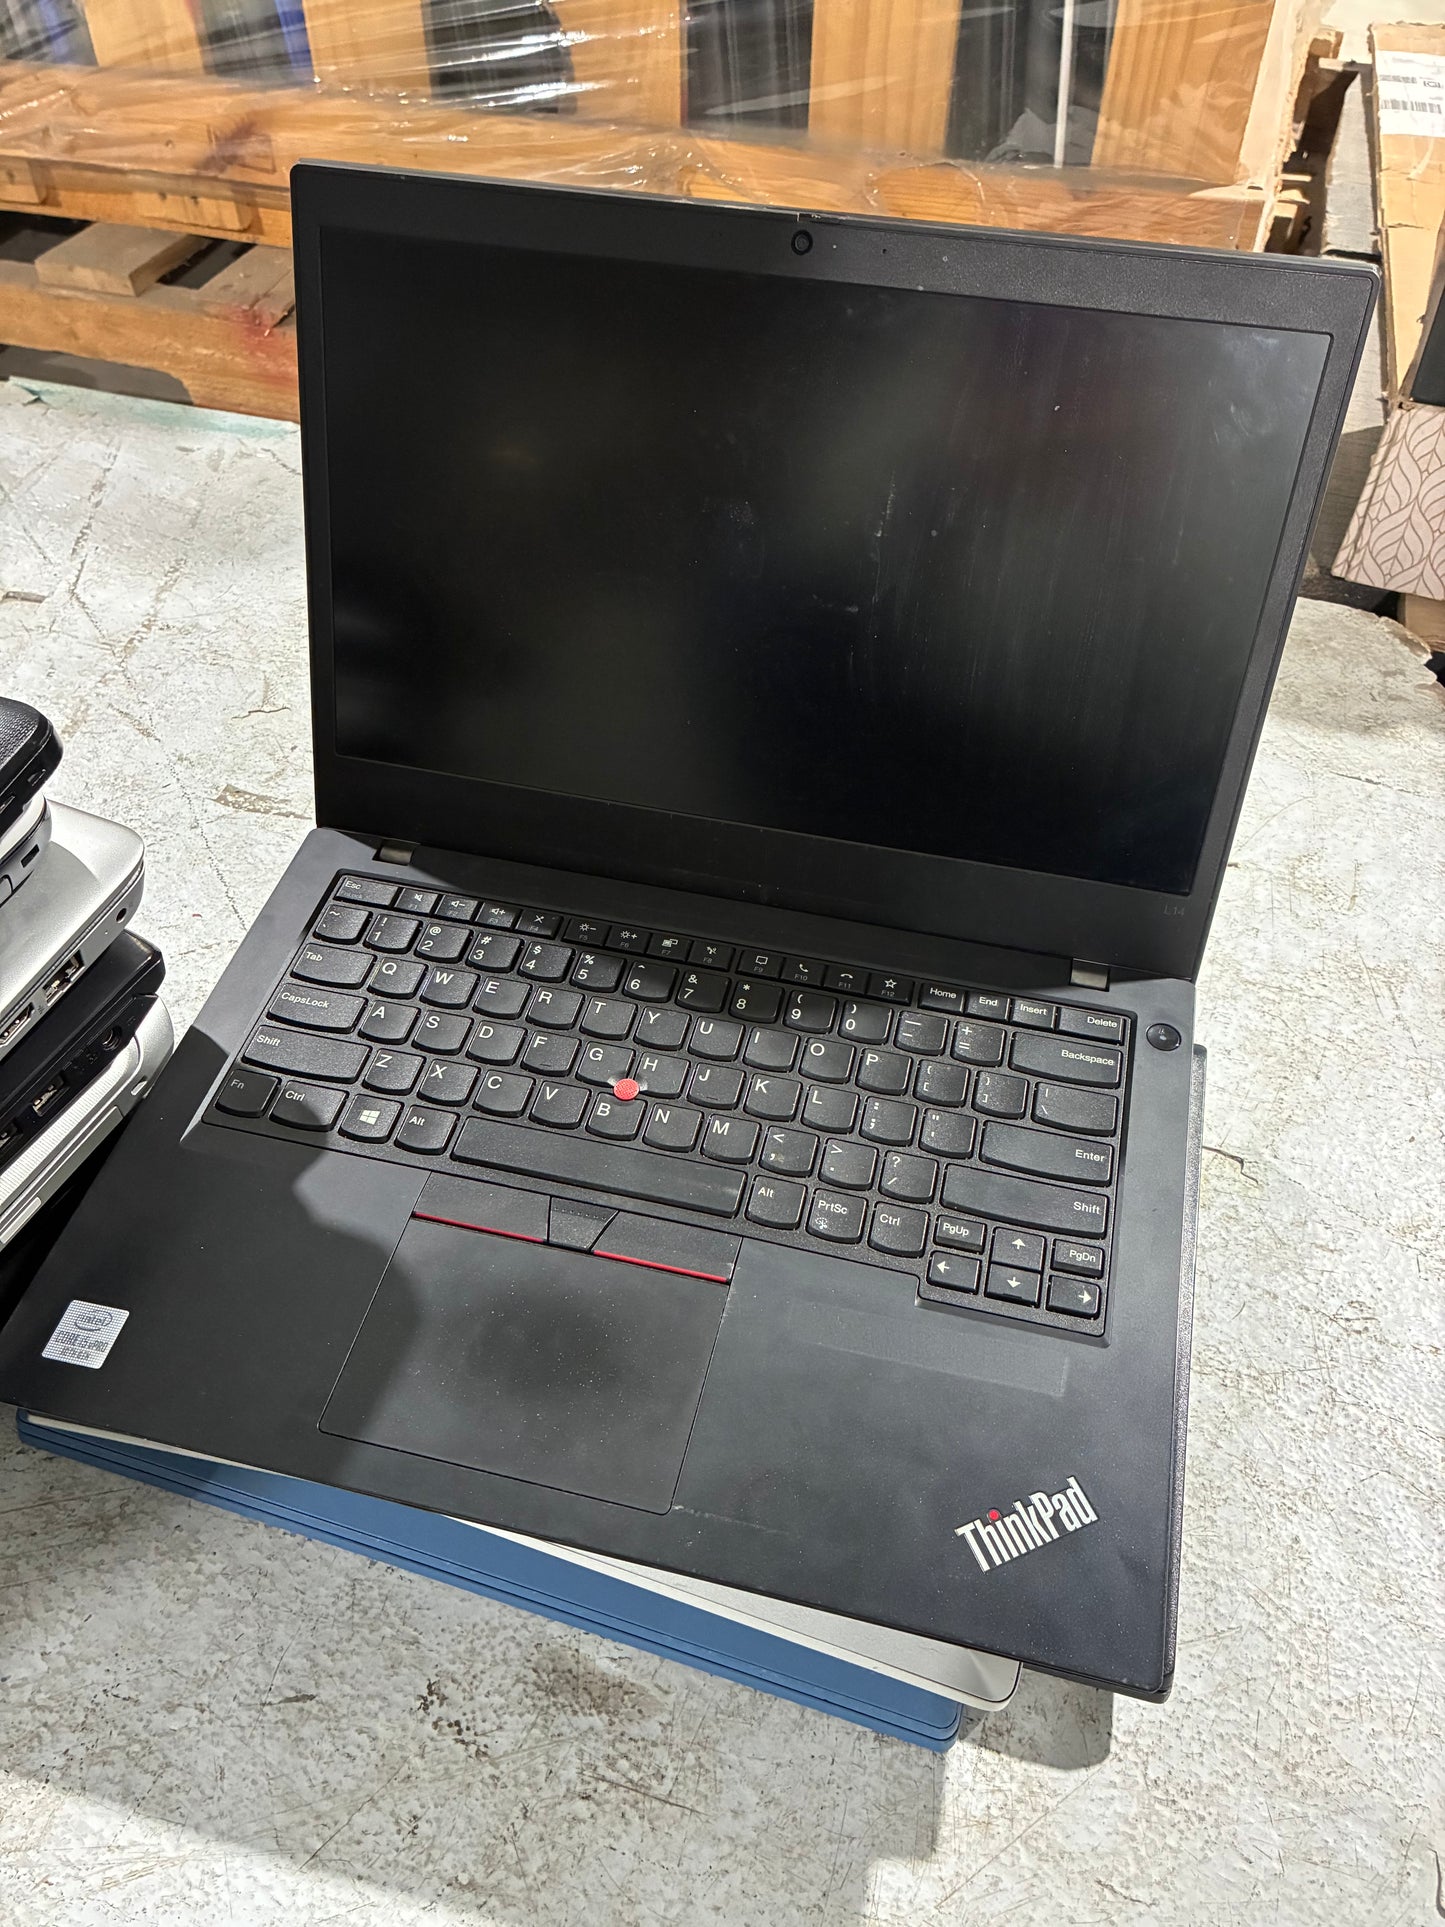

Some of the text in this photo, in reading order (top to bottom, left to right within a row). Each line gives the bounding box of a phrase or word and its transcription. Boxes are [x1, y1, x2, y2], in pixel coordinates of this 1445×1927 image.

[345, 880, 361, 890] Esc
[1164, 905, 1185, 916] L14
[380, 916, 388, 927] !
[374, 931, 380, 941] 1
[429, 925, 442, 937] @
[422, 940, 432, 951] 2
[480, 935, 493, 945] #
[473, 949, 484, 960] 3
[533, 945, 543, 955] $
[306, 951, 323, 962] Tab
[585, 954, 595, 965] %
[382, 962, 397, 975] Q
[526, 960, 536, 970] 4
[435, 972, 454, 985] W
[578, 969, 588, 980] 5
[688, 974, 698, 984] &
[485, 981, 500, 994] E
[630, 979, 641, 990] 6
[538, 991, 553, 1004] R
[683, 989, 694, 999] 7
[929, 987, 957, 1000] Home
[281, 992, 329, 1009] CapsLock
[736, 999, 747, 1010] 8
[978, 996, 998, 1006] End
[372, 1006, 386, 1019] A
[594, 1001, 607, 1014] T
[1019, 1003, 1048, 1016] Insert
[647, 1012, 661, 1024] Y
[790, 1009, 801, 1020] 9
[426, 1016, 441, 1029] S
[1086, 1016, 1118, 1028] Delete
[479, 1026, 494, 1039] D
[699, 1022, 713, 1035] U
[961, 1026, 973, 1036] +
[256, 1034, 281, 1047] Shift
[532, 1036, 548, 1048] F
[753, 1032, 760, 1044] I
[810, 1043, 825, 1056] O
[959, 1041, 971, 1049] =
[375, 1054, 393, 1068] Z
[589, 1048, 604, 1062] G
[866, 1053, 879, 1066] P
[1061, 1050, 1114, 1066] Backspace
[431, 1065, 447, 1079] X
[643, 1060, 658, 1072] H
[698, 1069, 711, 1082] J
[230, 1079, 245, 1089] Fn
[487, 1075, 503, 1089] C
[754, 1079, 770, 1093] K
[285, 1089, 305, 1101] Ctrl
[544, 1086, 559, 1100] V
[812, 1091, 823, 1105] L
[597, 1103, 611, 1117] B
[409, 1115, 425, 1127] Alt
[654, 1109, 671, 1124] N
[712, 1122, 730, 1136] M
[772, 1133, 785, 1143] <
[830, 1144, 843, 1155] >
[892, 1157, 900, 1168] ?
[1074, 1150, 1106, 1163] Enter
[758, 1187, 775, 1198] Alt
[817, 1200, 848, 1215] PrtSc
[1073, 1201, 1101, 1215] Shift
[879, 1214, 900, 1226] Ctrl
[943, 1222, 970, 1236] PgUp
[1069, 1250, 1096, 1263] PgDn
[954, 1475, 1099, 1573] ThinkPad
